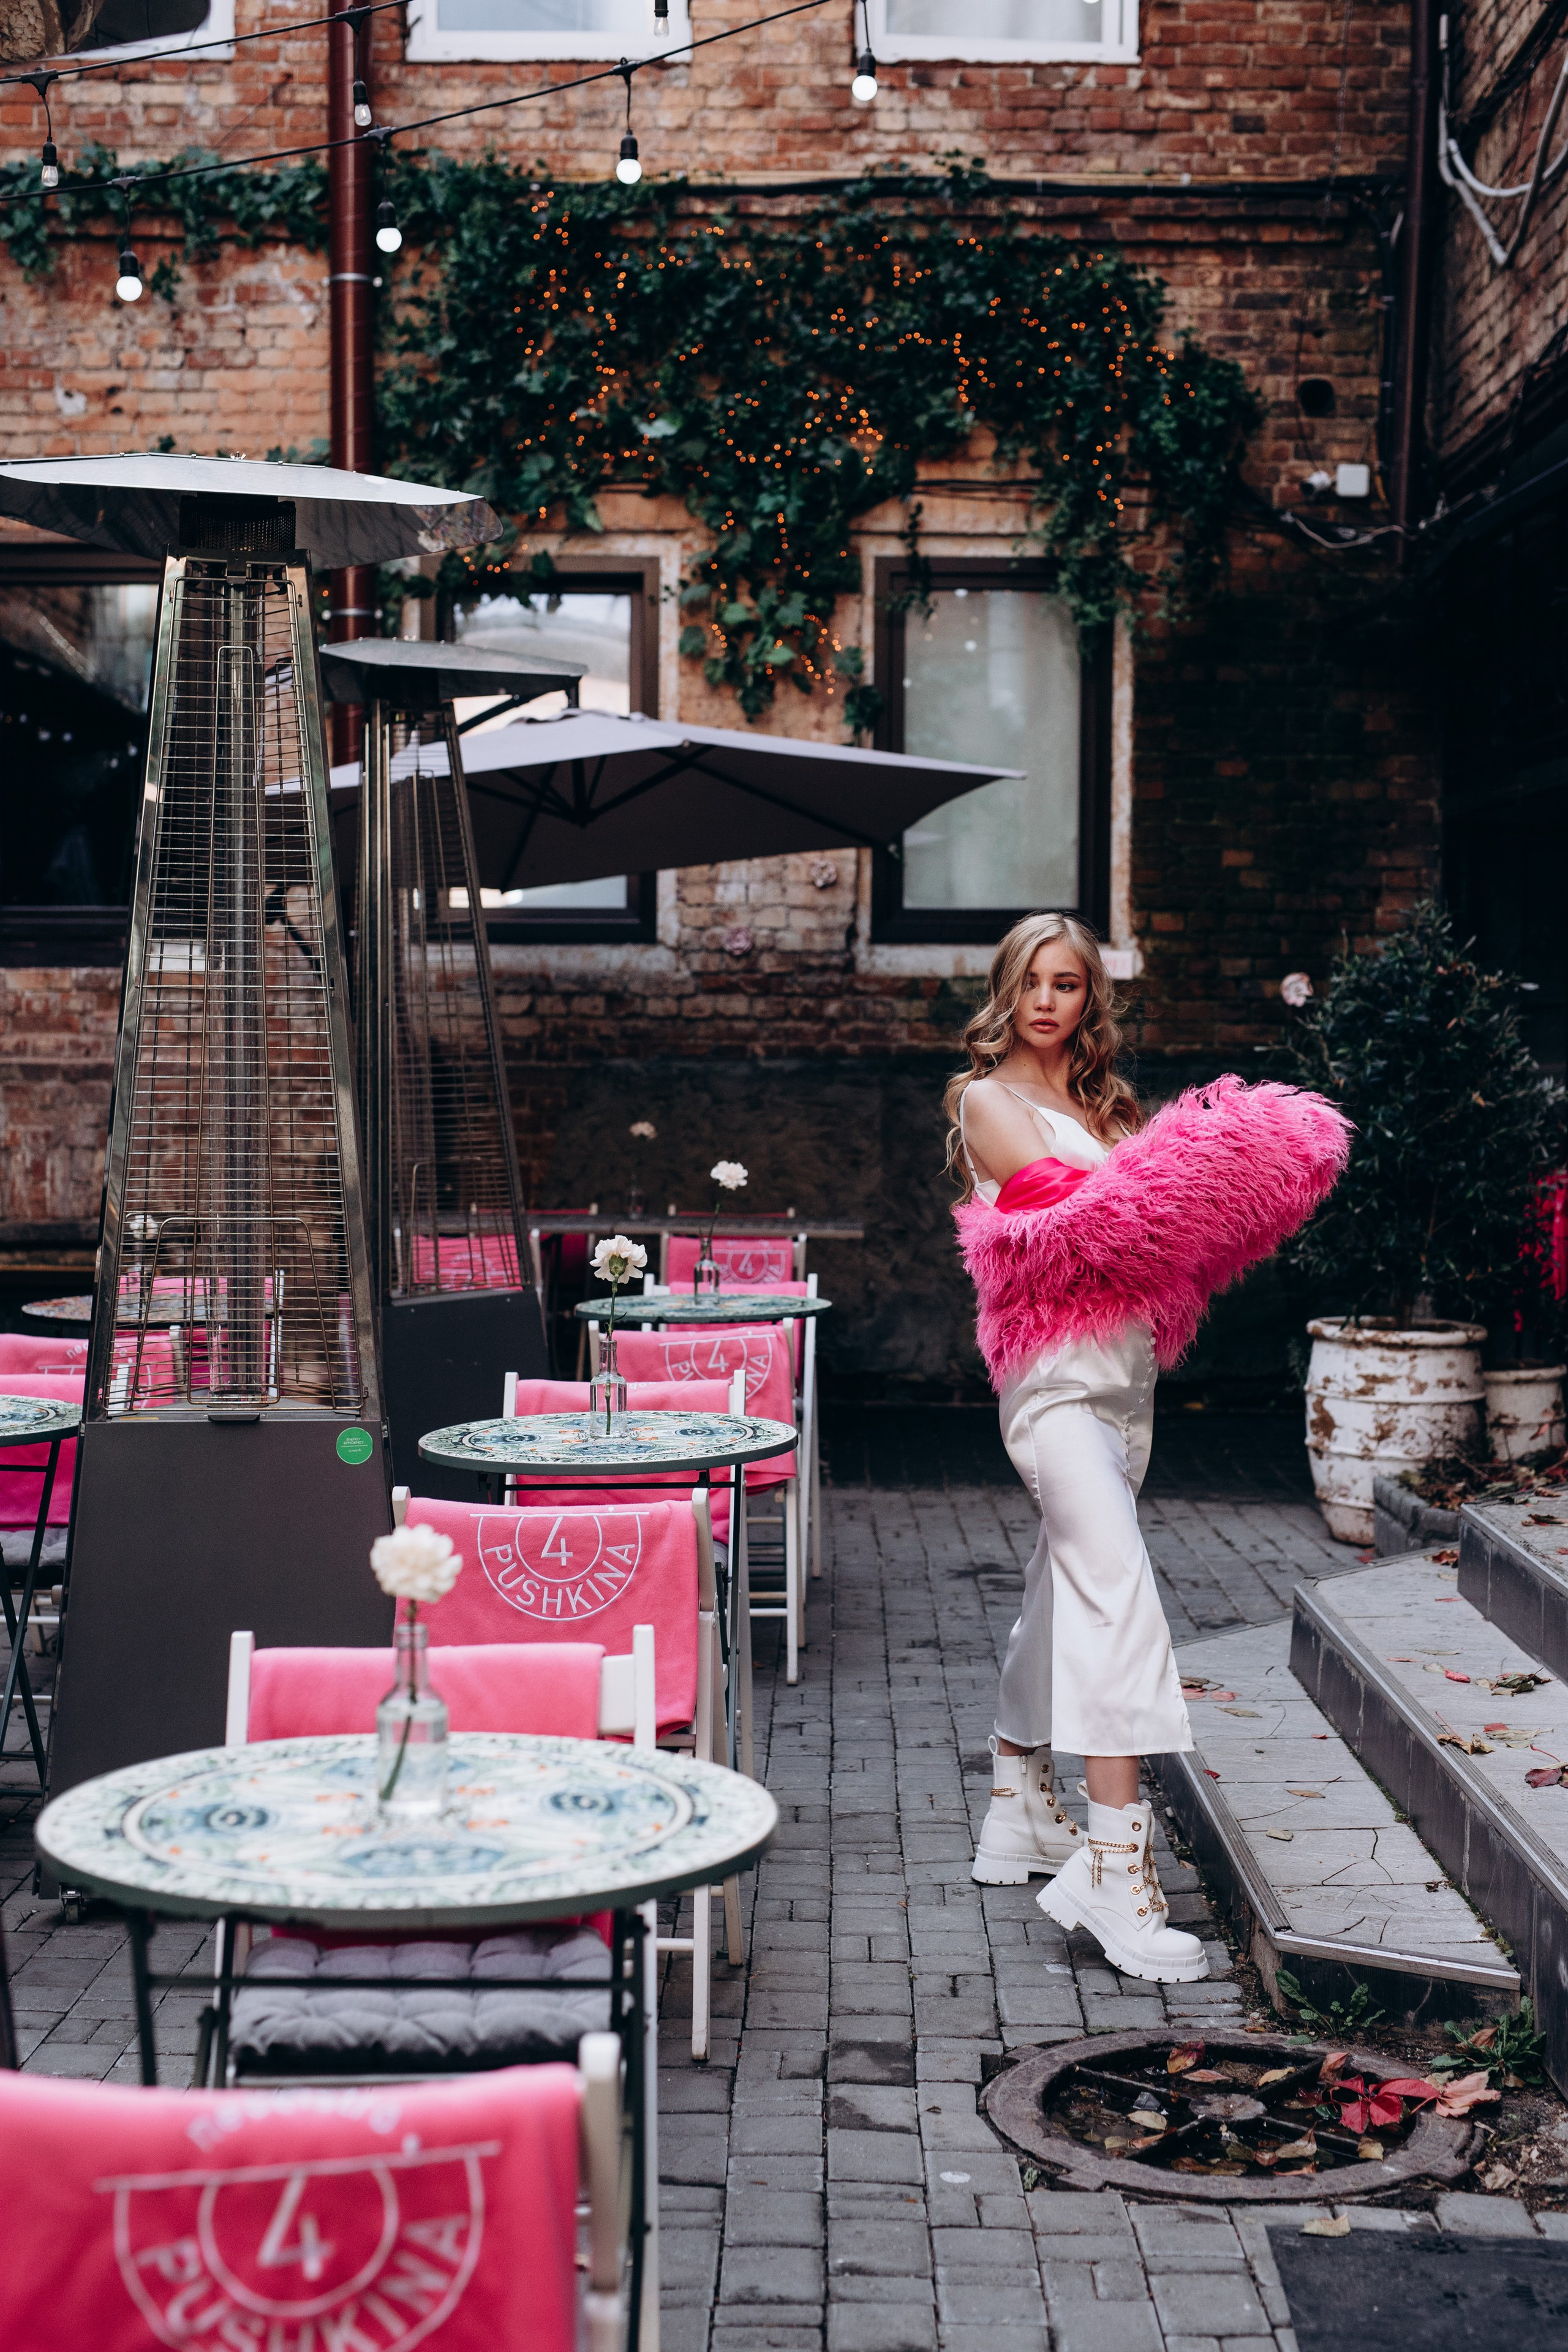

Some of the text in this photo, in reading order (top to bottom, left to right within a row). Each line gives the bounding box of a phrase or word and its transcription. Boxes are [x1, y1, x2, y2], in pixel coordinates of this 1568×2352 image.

[707, 1340, 729, 1373] 4
[541, 1517, 573, 1566] 4
[484, 1544, 636, 1615] PUSHKINA
[256, 2168, 336, 2281] 4
